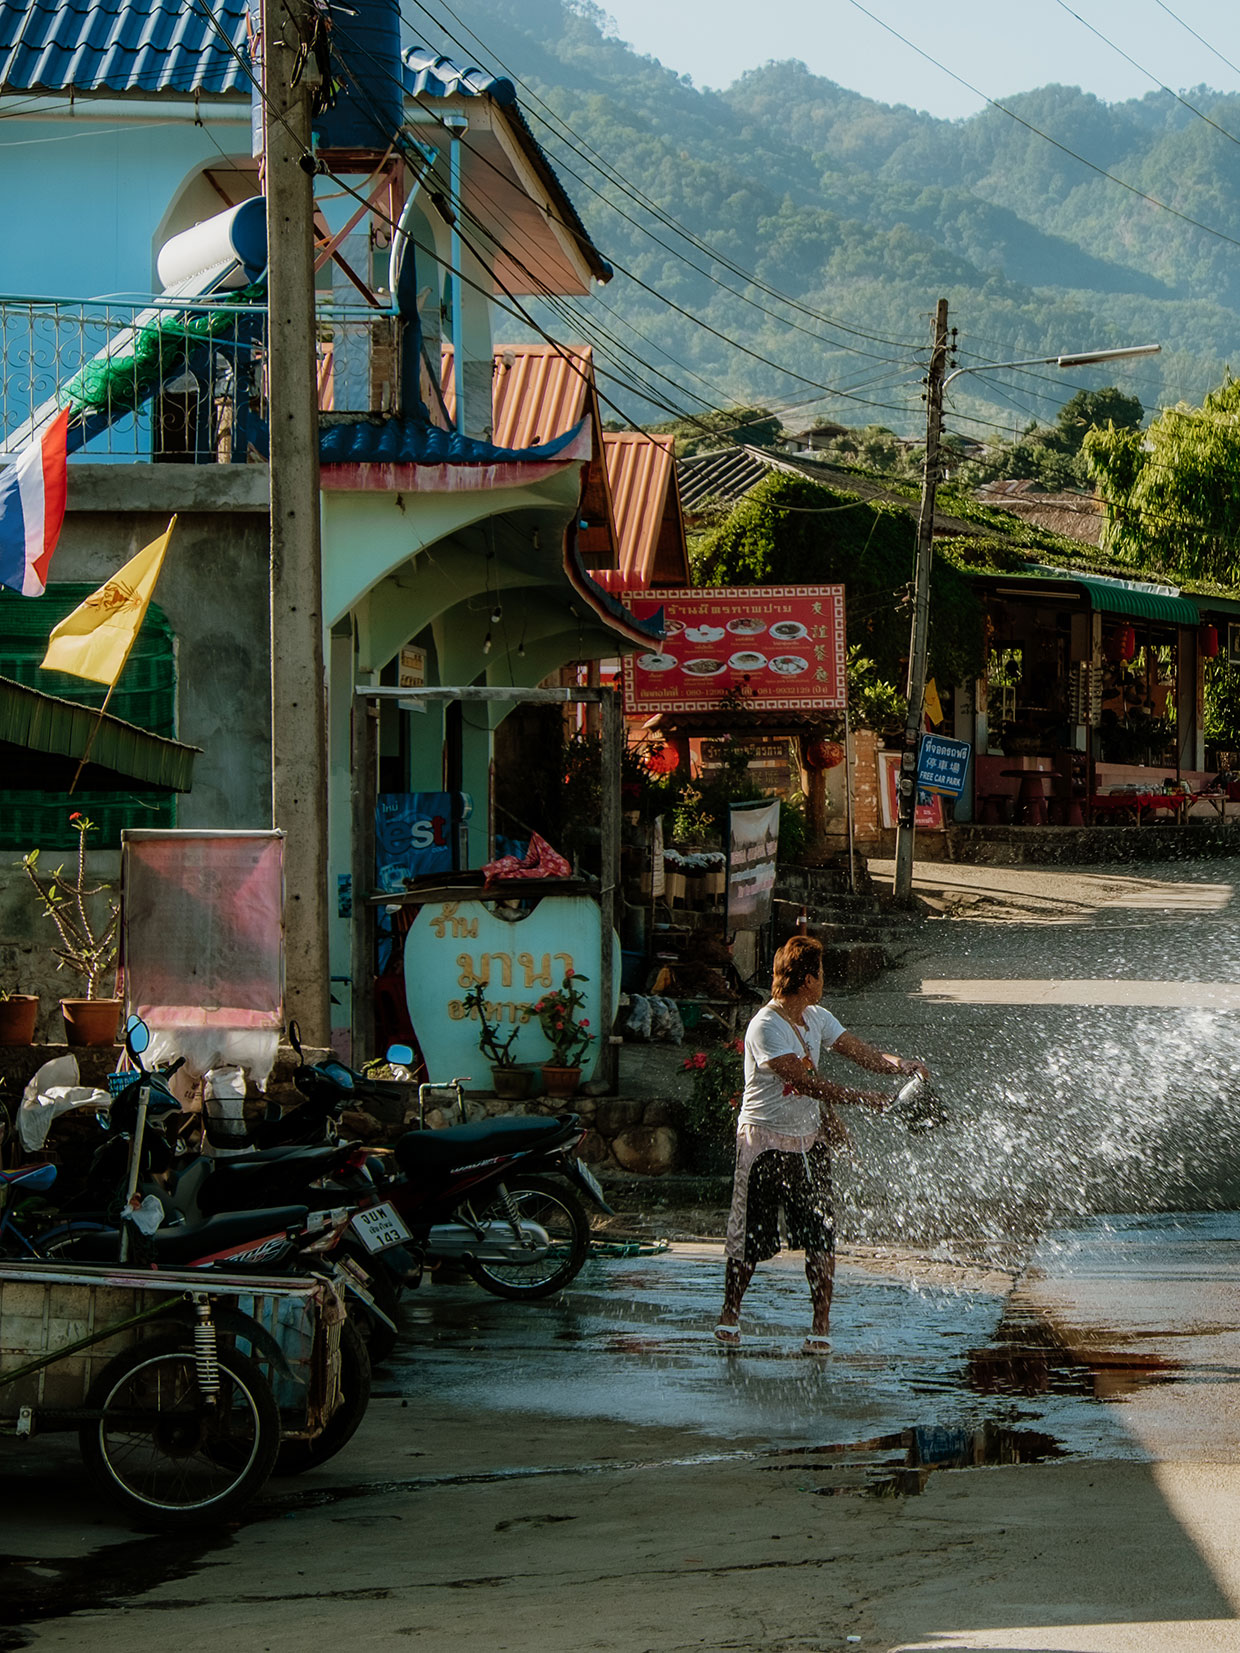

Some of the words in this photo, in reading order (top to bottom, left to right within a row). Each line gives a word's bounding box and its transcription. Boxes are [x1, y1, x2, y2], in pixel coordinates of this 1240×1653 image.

[919, 770, 934, 781] FREE
[934, 774, 946, 784] CAR
[946, 776, 961, 787] PARK
[429, 902, 479, 938] ร้าน
[457, 952, 574, 988] มานา
[376, 1229, 401, 1245] 143
